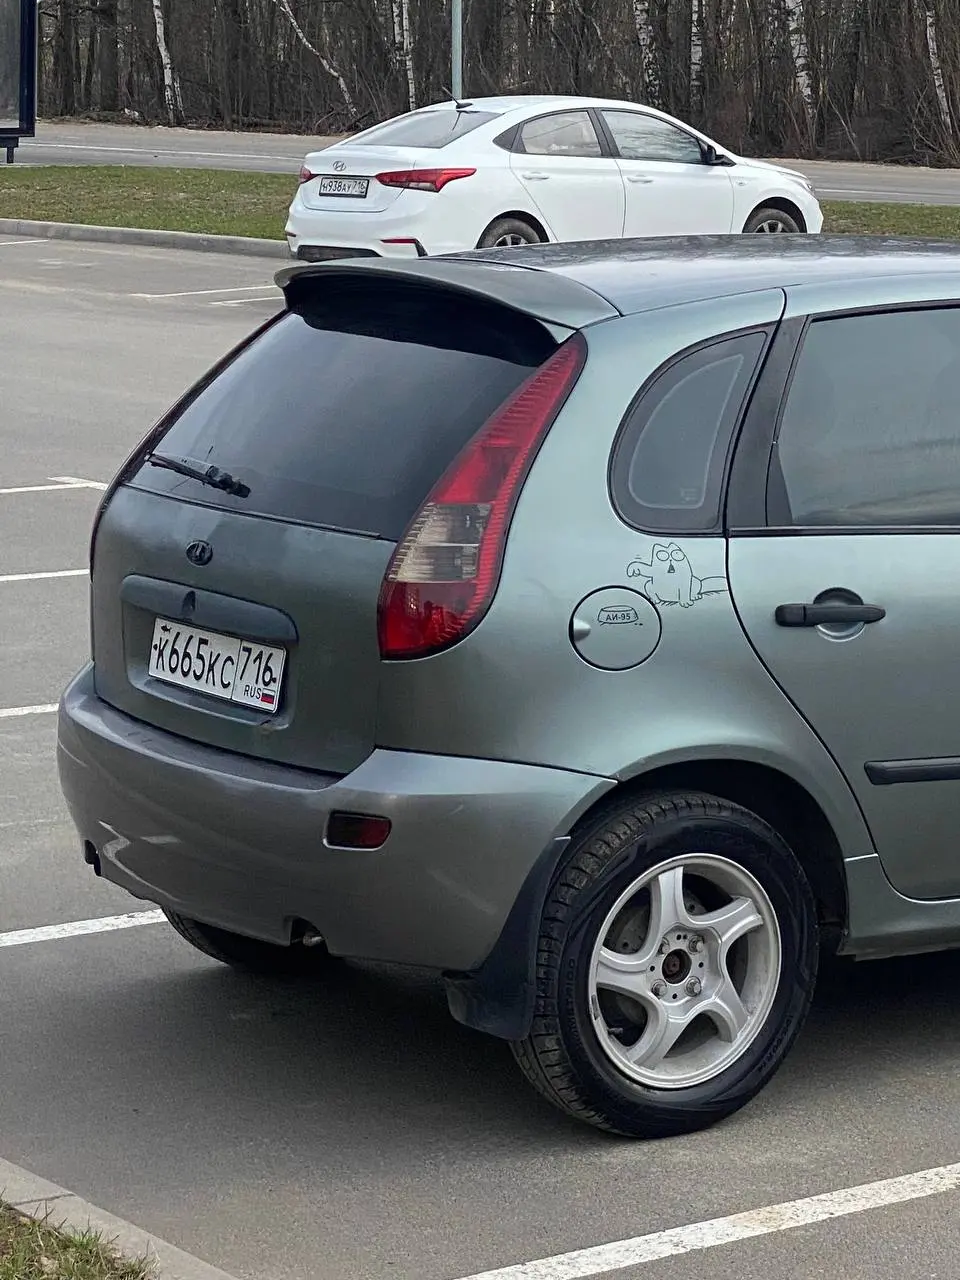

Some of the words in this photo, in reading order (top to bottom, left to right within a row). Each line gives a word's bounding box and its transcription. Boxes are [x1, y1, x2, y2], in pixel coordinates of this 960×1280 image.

[606, 613, 631, 622] АИ-95
[155, 631, 235, 689] К665КС
[239, 645, 274, 687] 716
[243, 684, 261, 699] RUS
